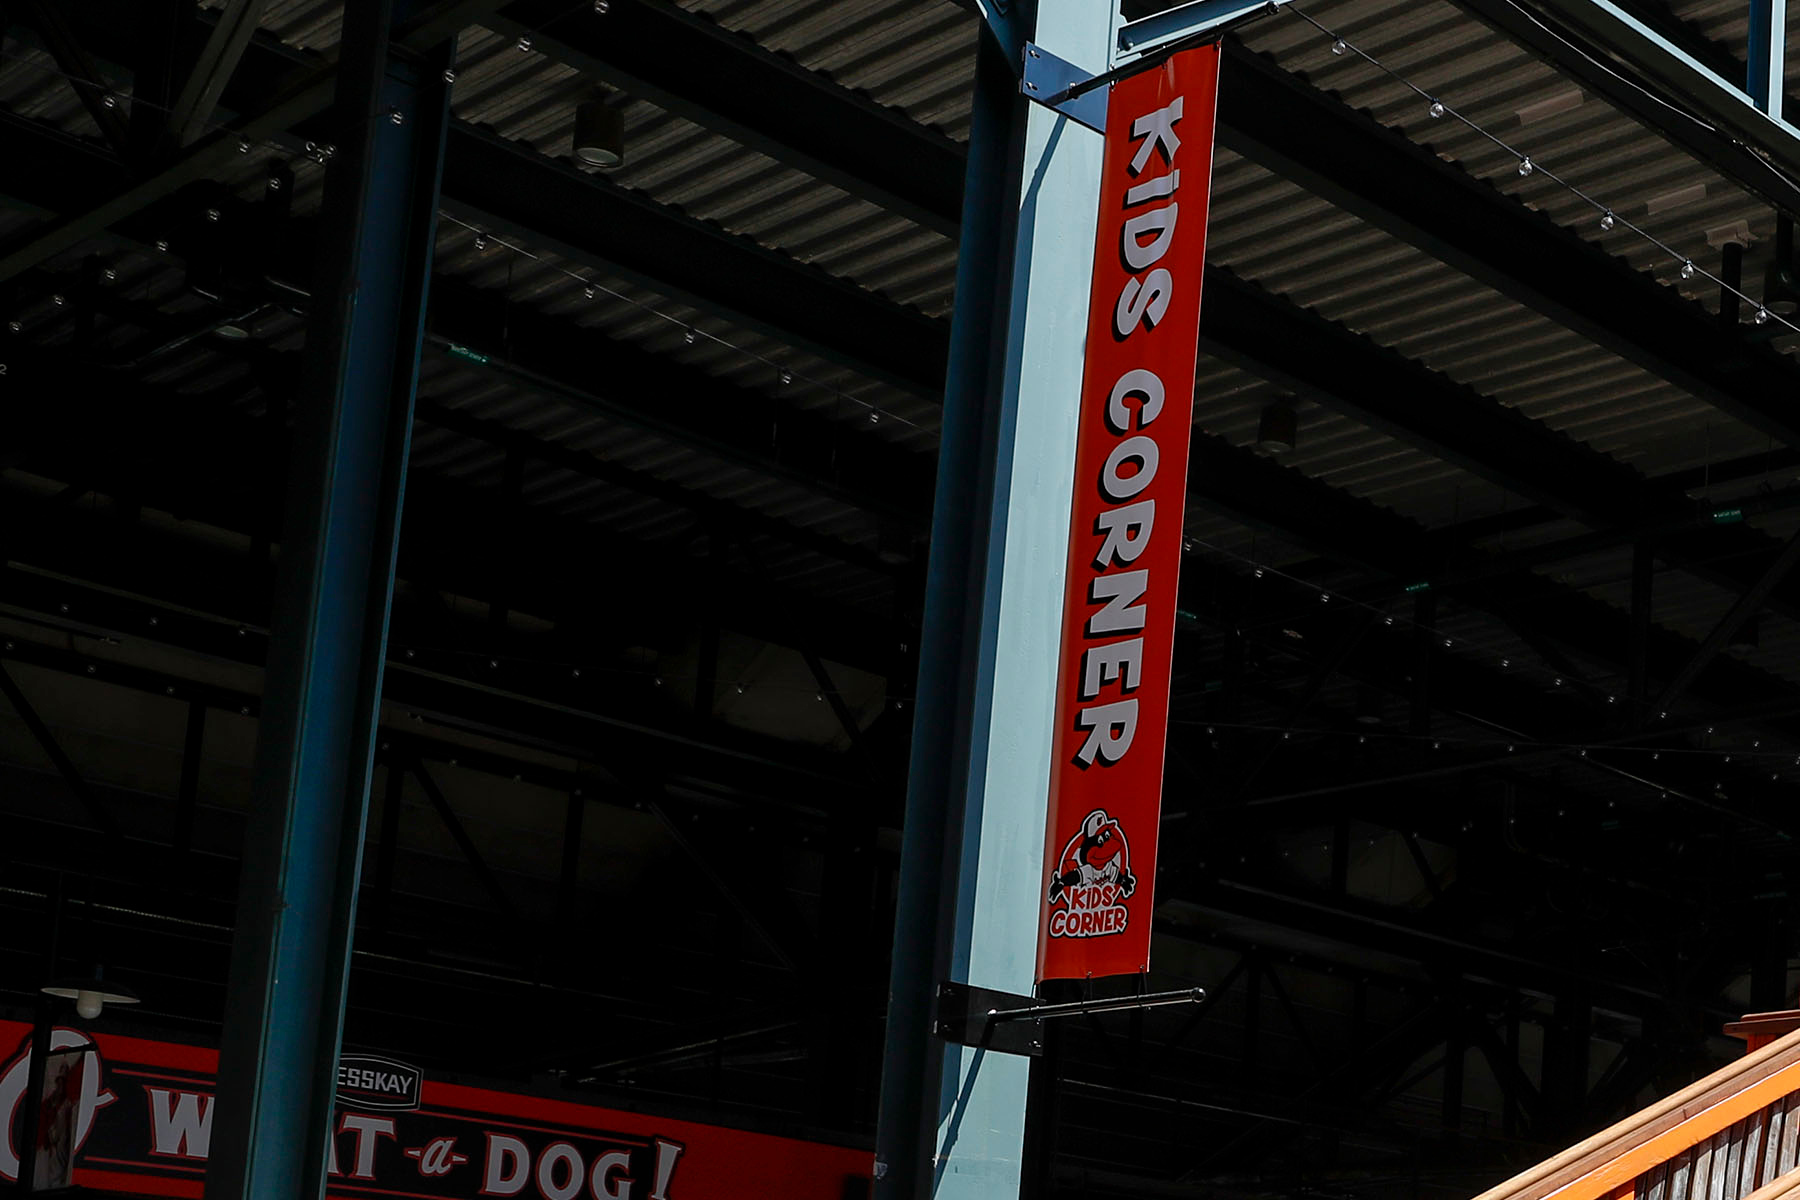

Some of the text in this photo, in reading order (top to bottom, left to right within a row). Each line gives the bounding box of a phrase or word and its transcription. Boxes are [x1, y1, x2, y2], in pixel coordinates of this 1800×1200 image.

[1074, 96, 1184, 767] KIDS CORNER
[1051, 908, 1127, 935] CORNER
